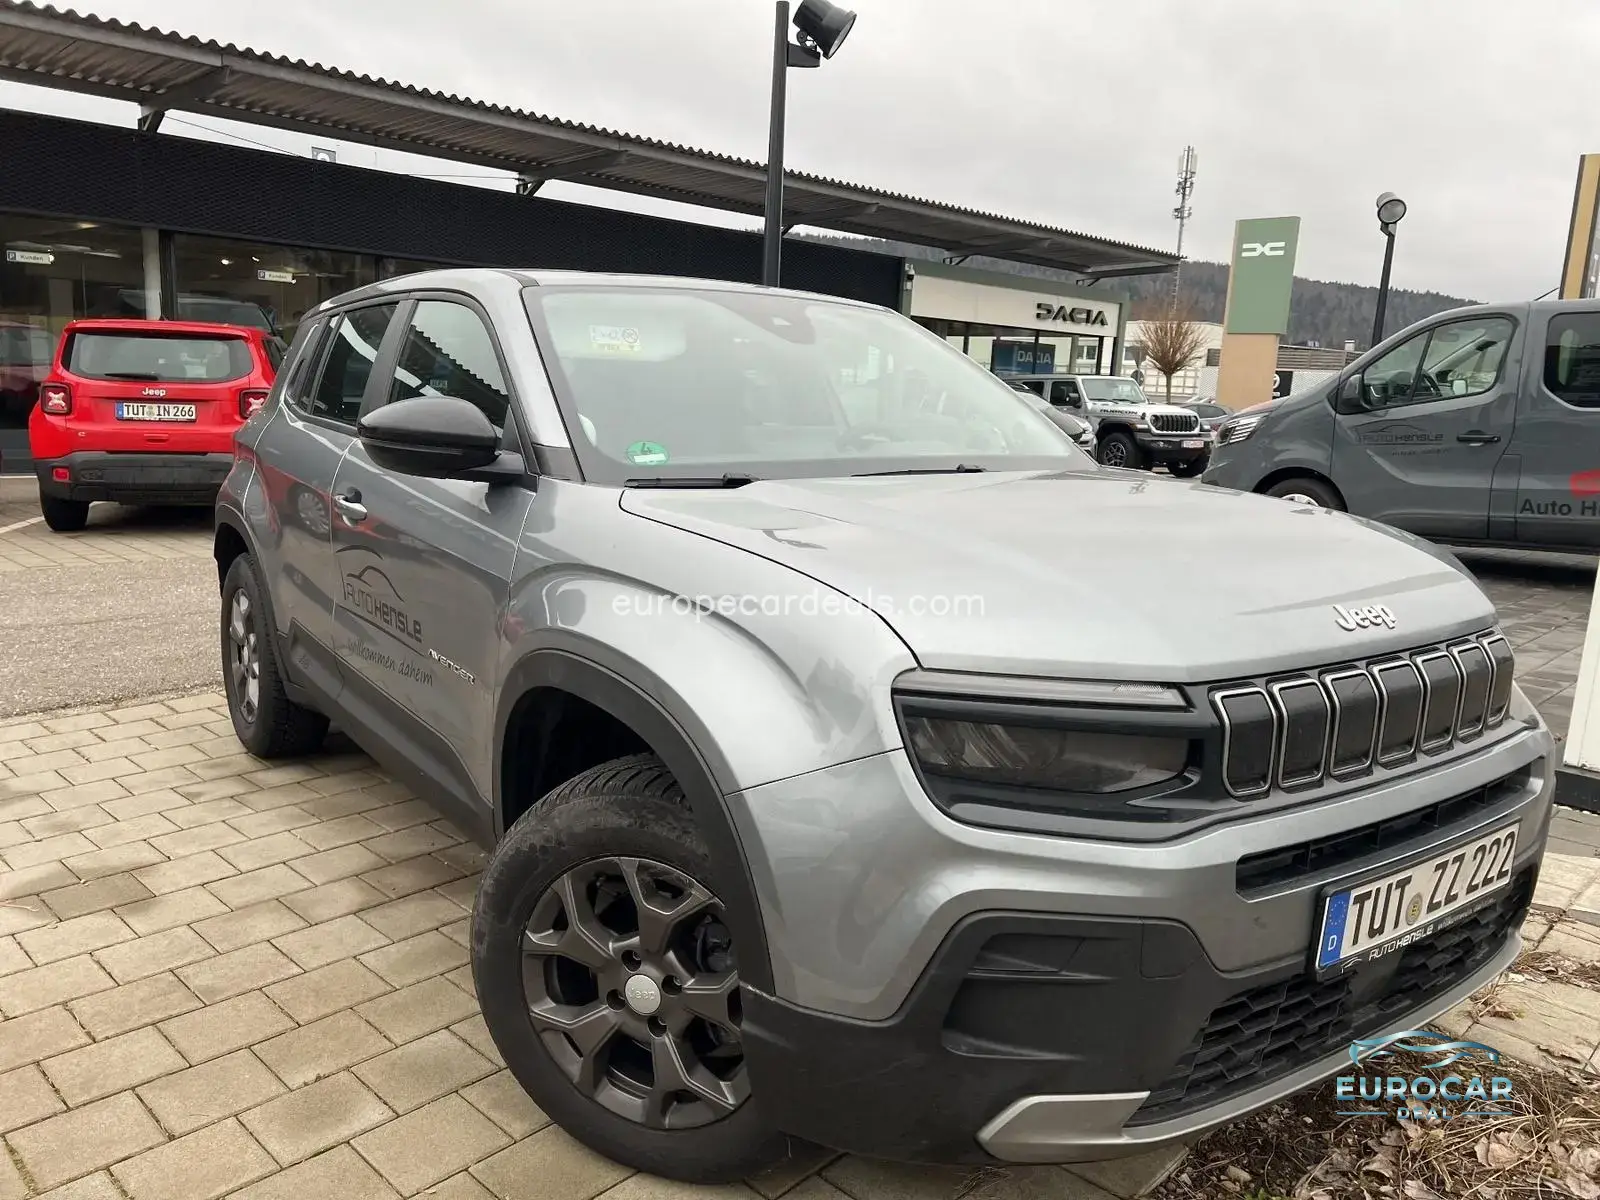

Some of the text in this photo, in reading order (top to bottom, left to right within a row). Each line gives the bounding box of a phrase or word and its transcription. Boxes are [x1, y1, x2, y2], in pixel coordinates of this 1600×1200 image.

[1036, 303, 1109, 326] DACIA
[142, 387, 166, 397] Jeep
[124, 404, 194, 418] TUT IN 266
[1519, 498, 1600, 517] Auto H
[1332, 604, 1397, 633] Jeep
[398, 655, 434, 687] daheim
[428, 648, 476, 685] AVENGER
[1351, 874, 1413, 946] TUT
[1426, 852, 1467, 915] ZZ
[1465, 830, 1516, 896] 222
[1327, 934, 1338, 951] D
